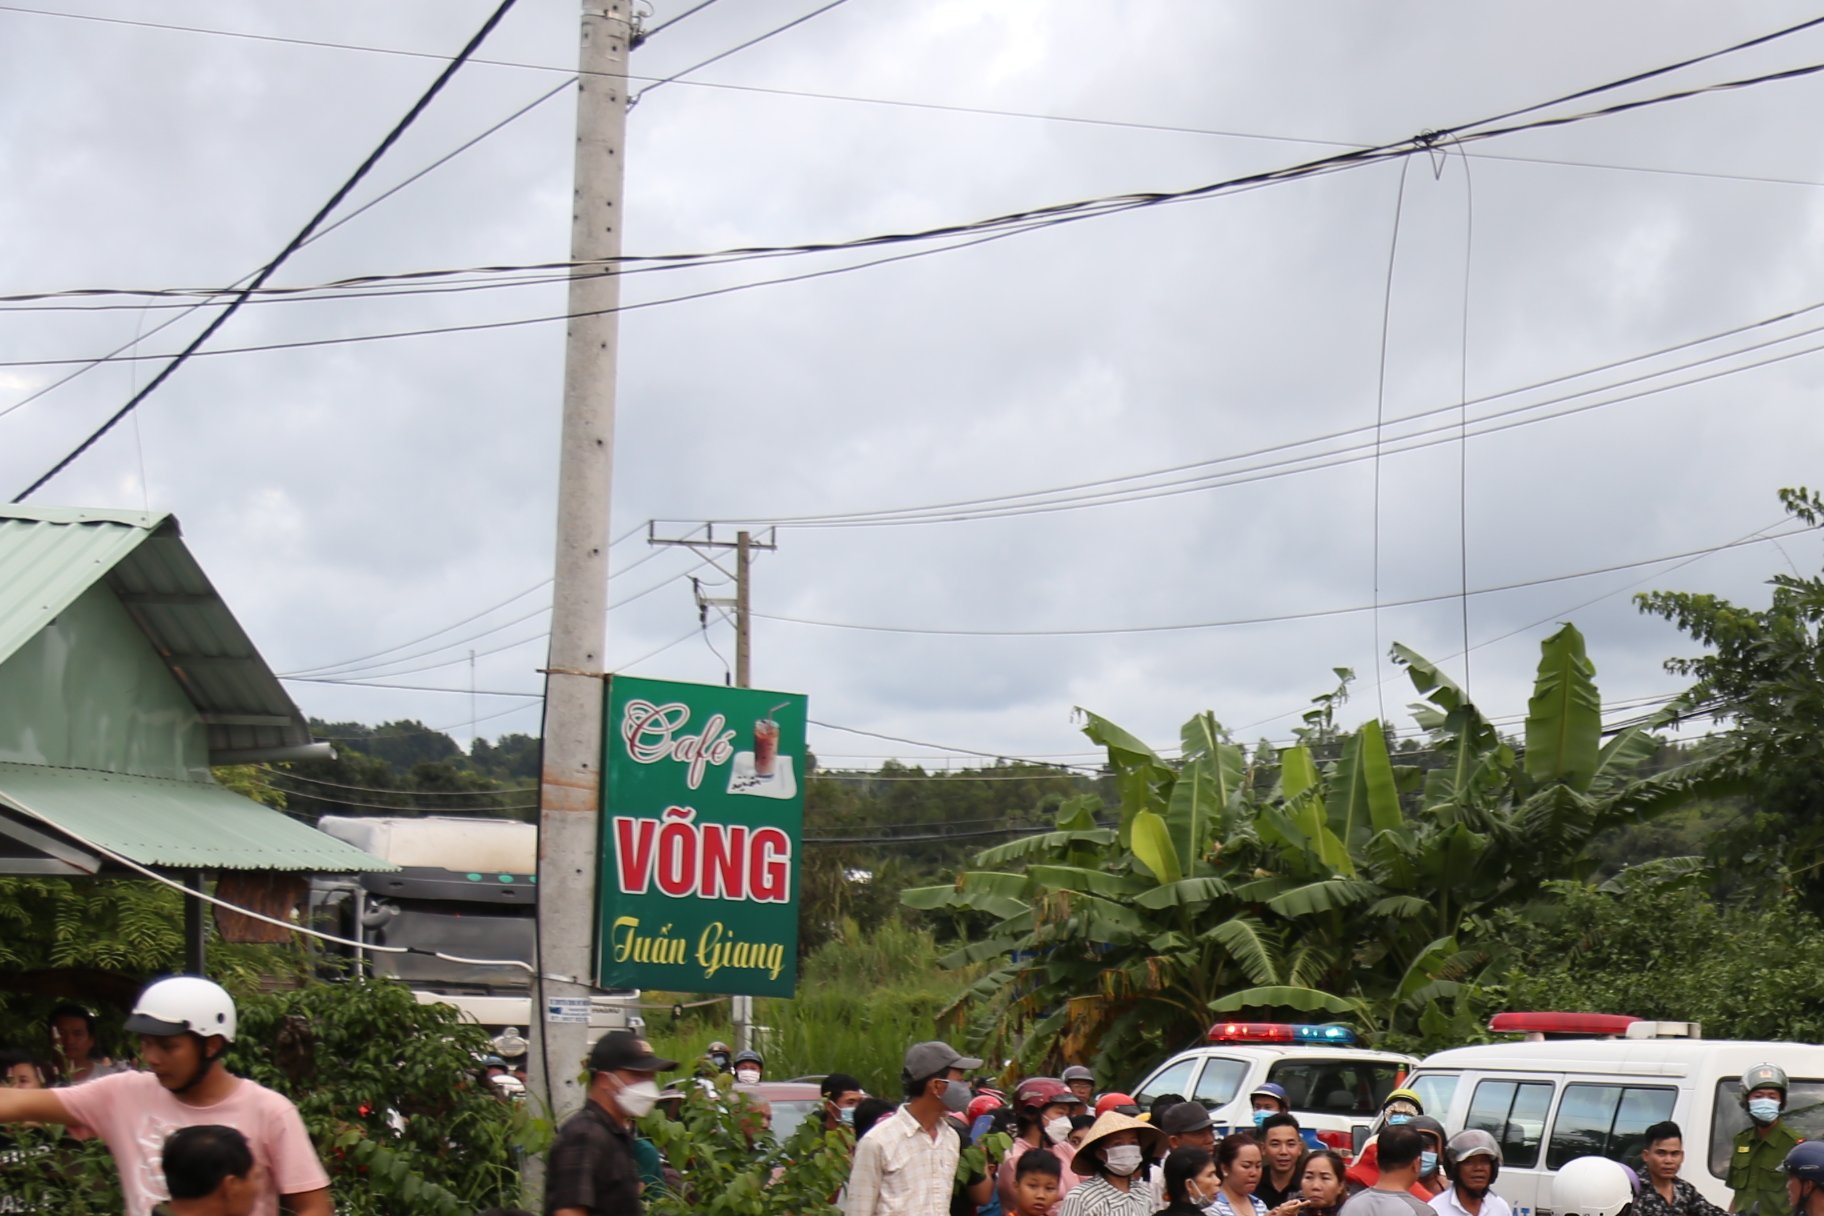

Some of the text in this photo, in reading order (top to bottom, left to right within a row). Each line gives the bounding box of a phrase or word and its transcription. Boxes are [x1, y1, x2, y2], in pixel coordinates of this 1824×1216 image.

[622, 700, 734, 789] Café
[614, 806, 791, 903] VÕNG
[612, 916, 784, 980] Tuấn Giang
